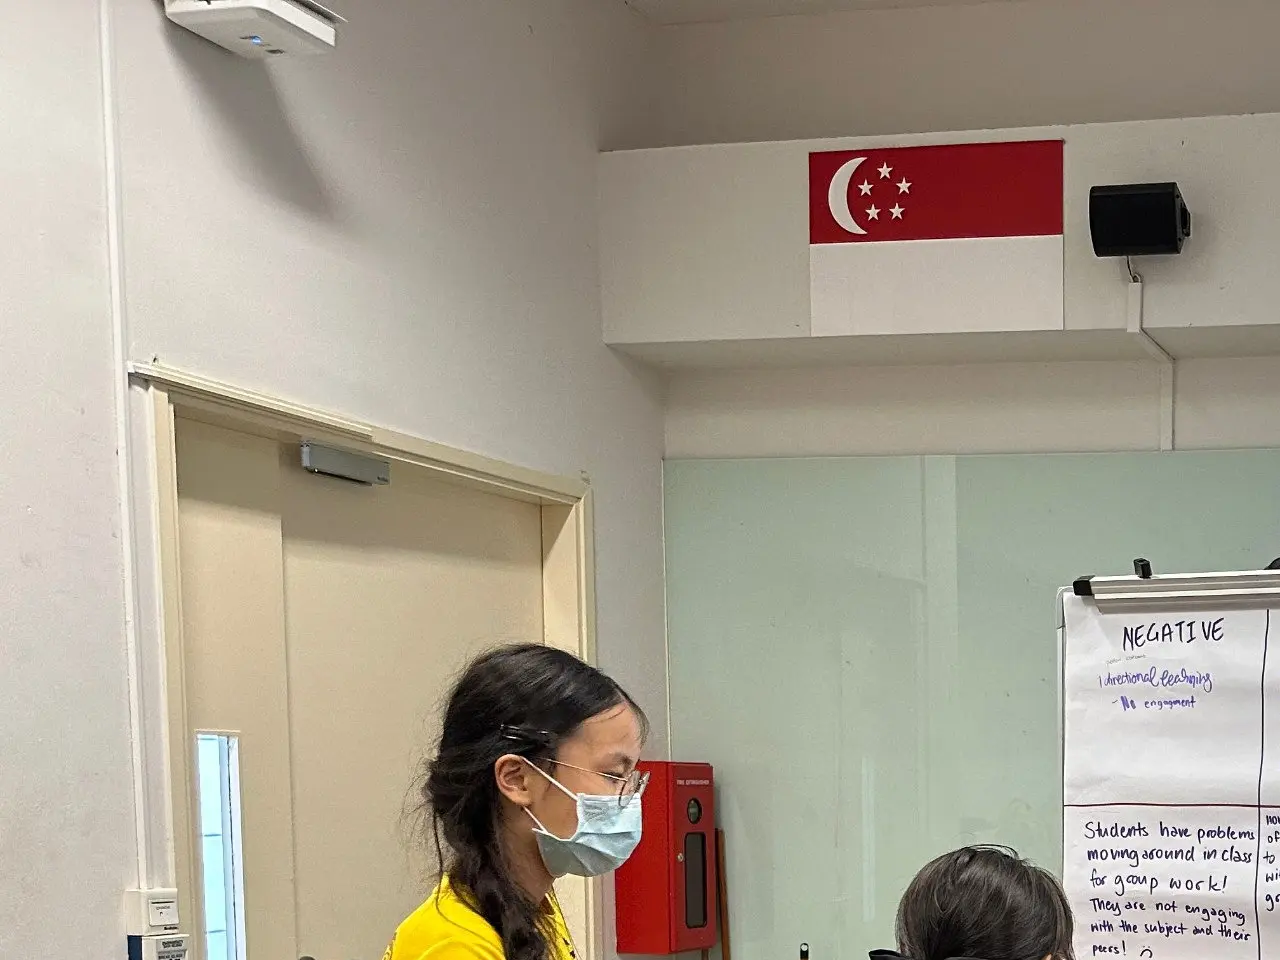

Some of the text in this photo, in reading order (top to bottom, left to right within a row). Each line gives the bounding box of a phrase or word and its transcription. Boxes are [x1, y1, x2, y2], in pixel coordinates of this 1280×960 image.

[1123, 617, 1225, 651] NEGATIVE
[1084, 821, 1255, 844] Students have problems
[1267, 831, 1280, 843] of
[1087, 845, 1252, 867] moving around in class
[1263, 852, 1276, 864] to
[1090, 868, 1228, 896] for group work!
[1089, 898, 1245, 926] They are not engaging
[1090, 920, 1251, 941] with the subject and their
[1093, 941, 1126, 956] peers!
